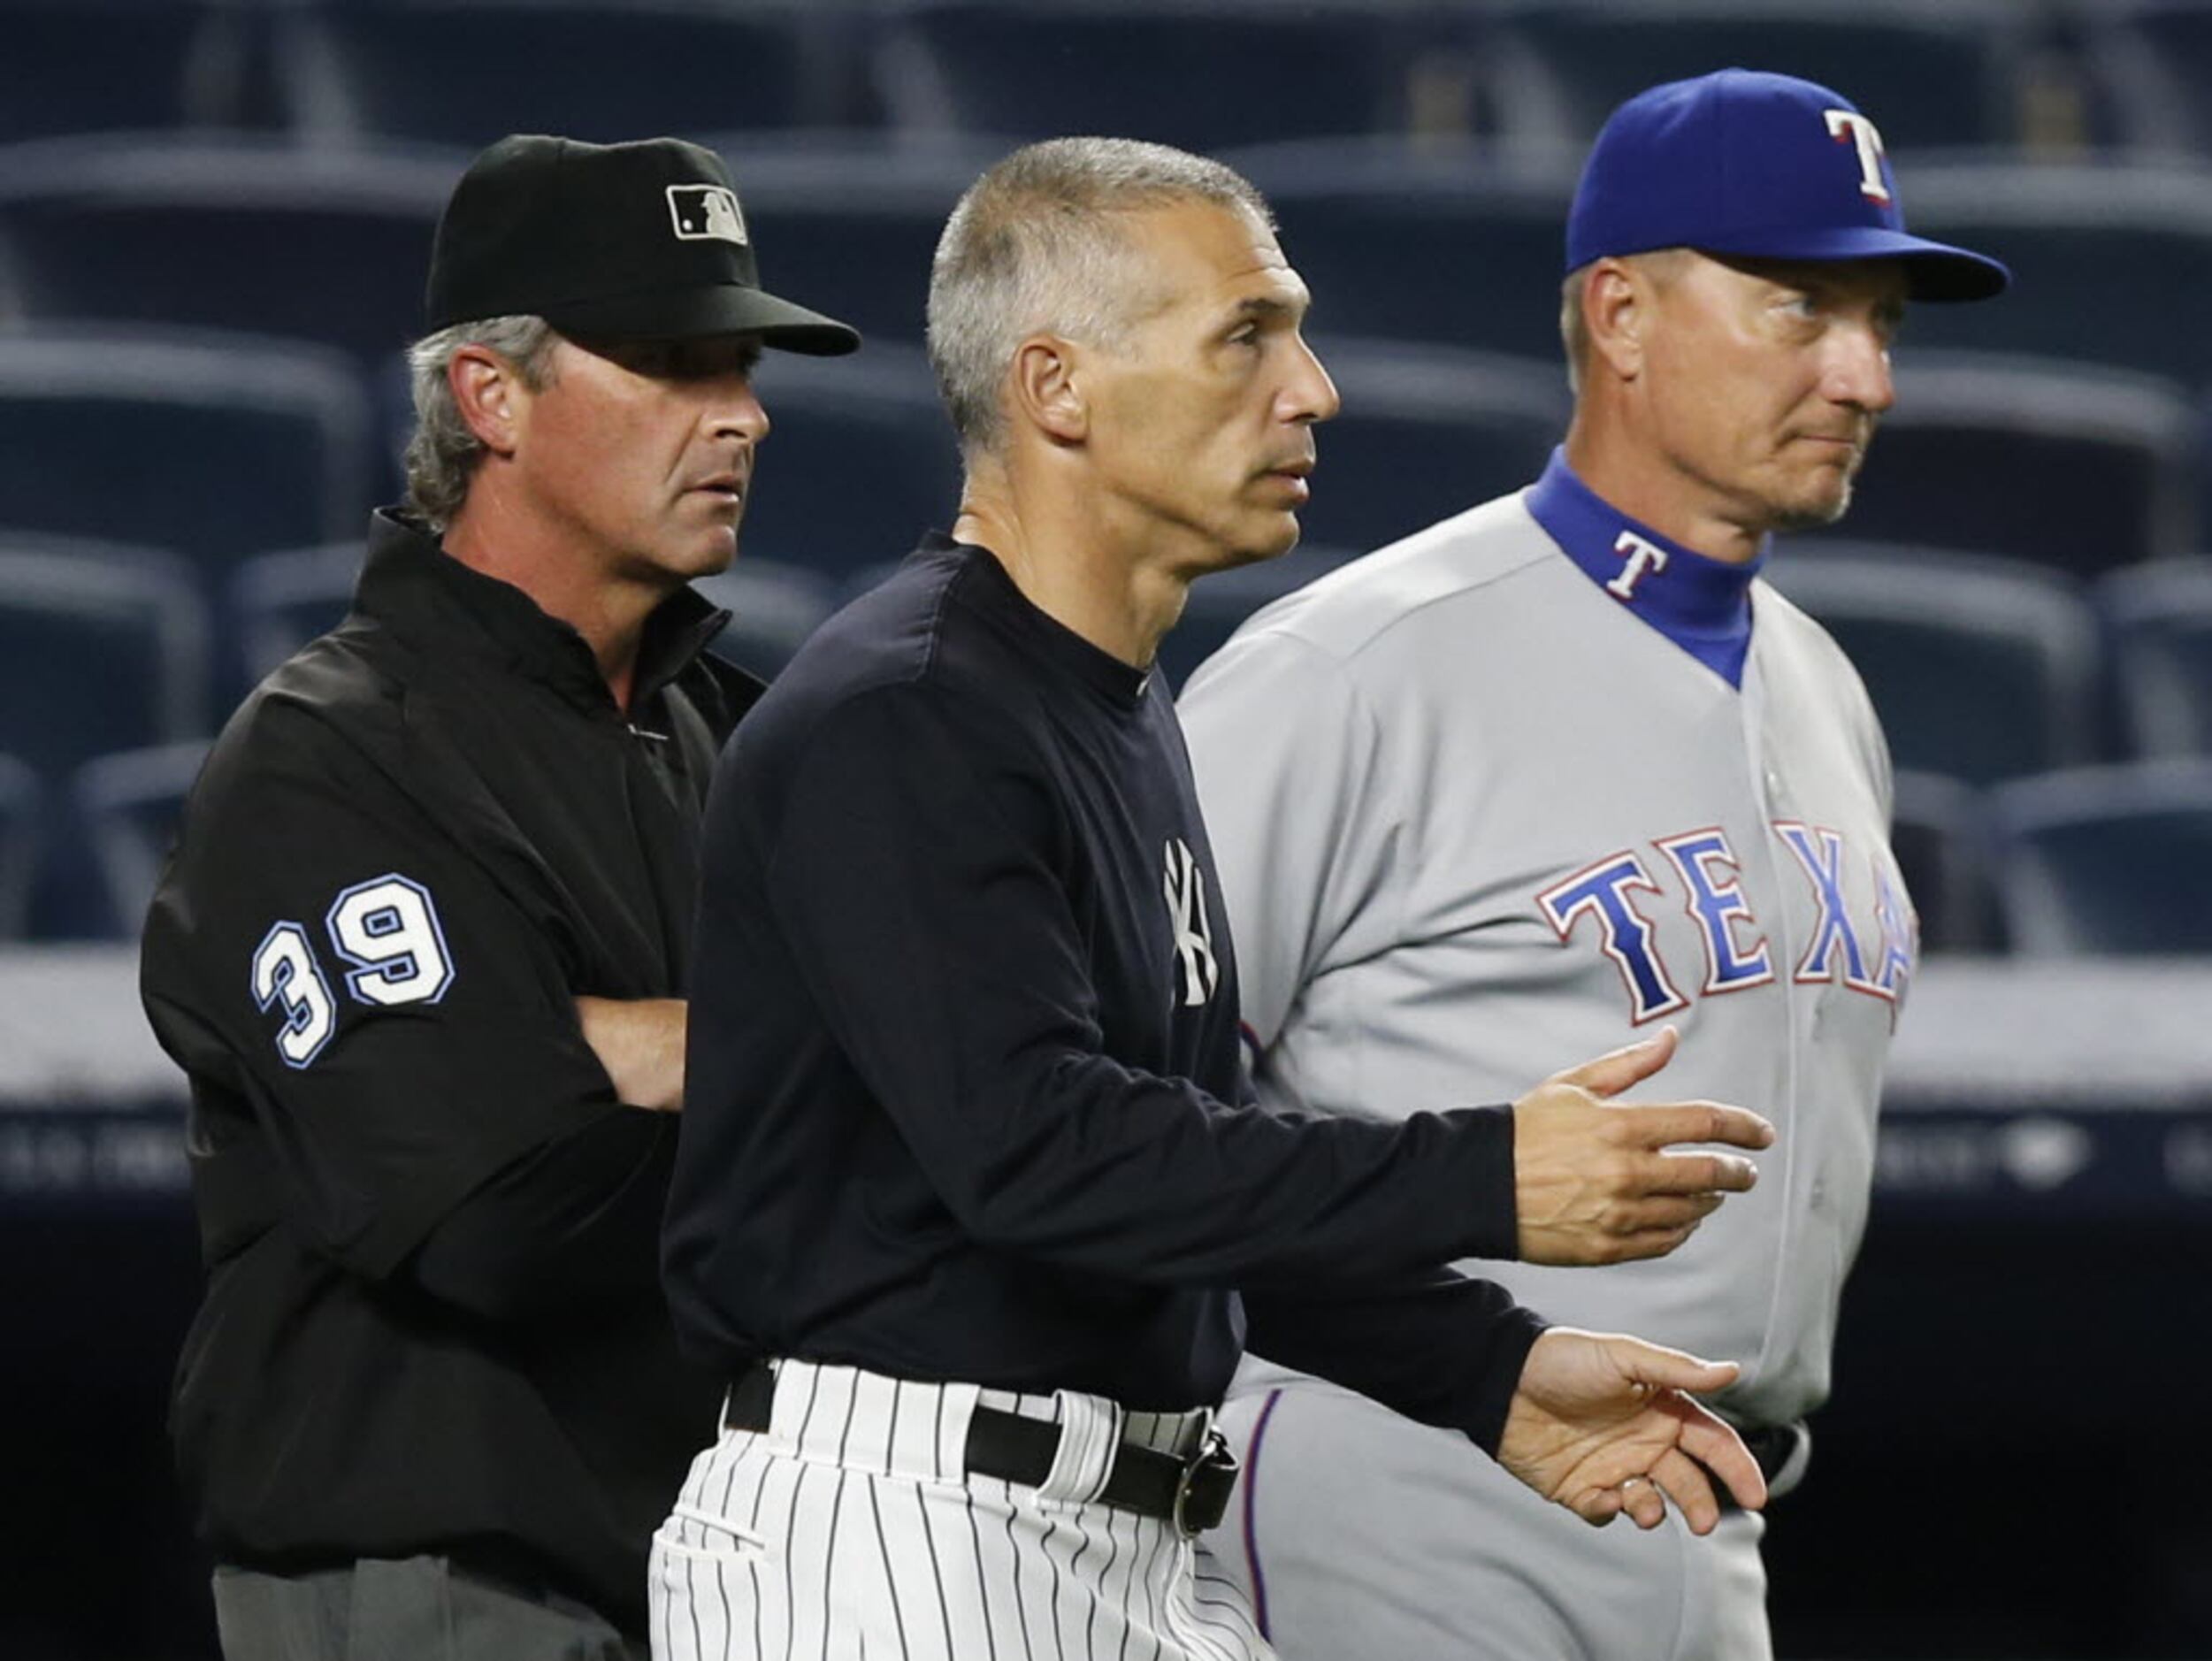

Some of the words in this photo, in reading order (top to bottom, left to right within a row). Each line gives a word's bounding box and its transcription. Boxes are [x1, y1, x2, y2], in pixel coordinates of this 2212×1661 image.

[1823, 109, 1893, 209] T
[1606, 530, 1669, 603] T
[251, 872, 455, 1069] 39
